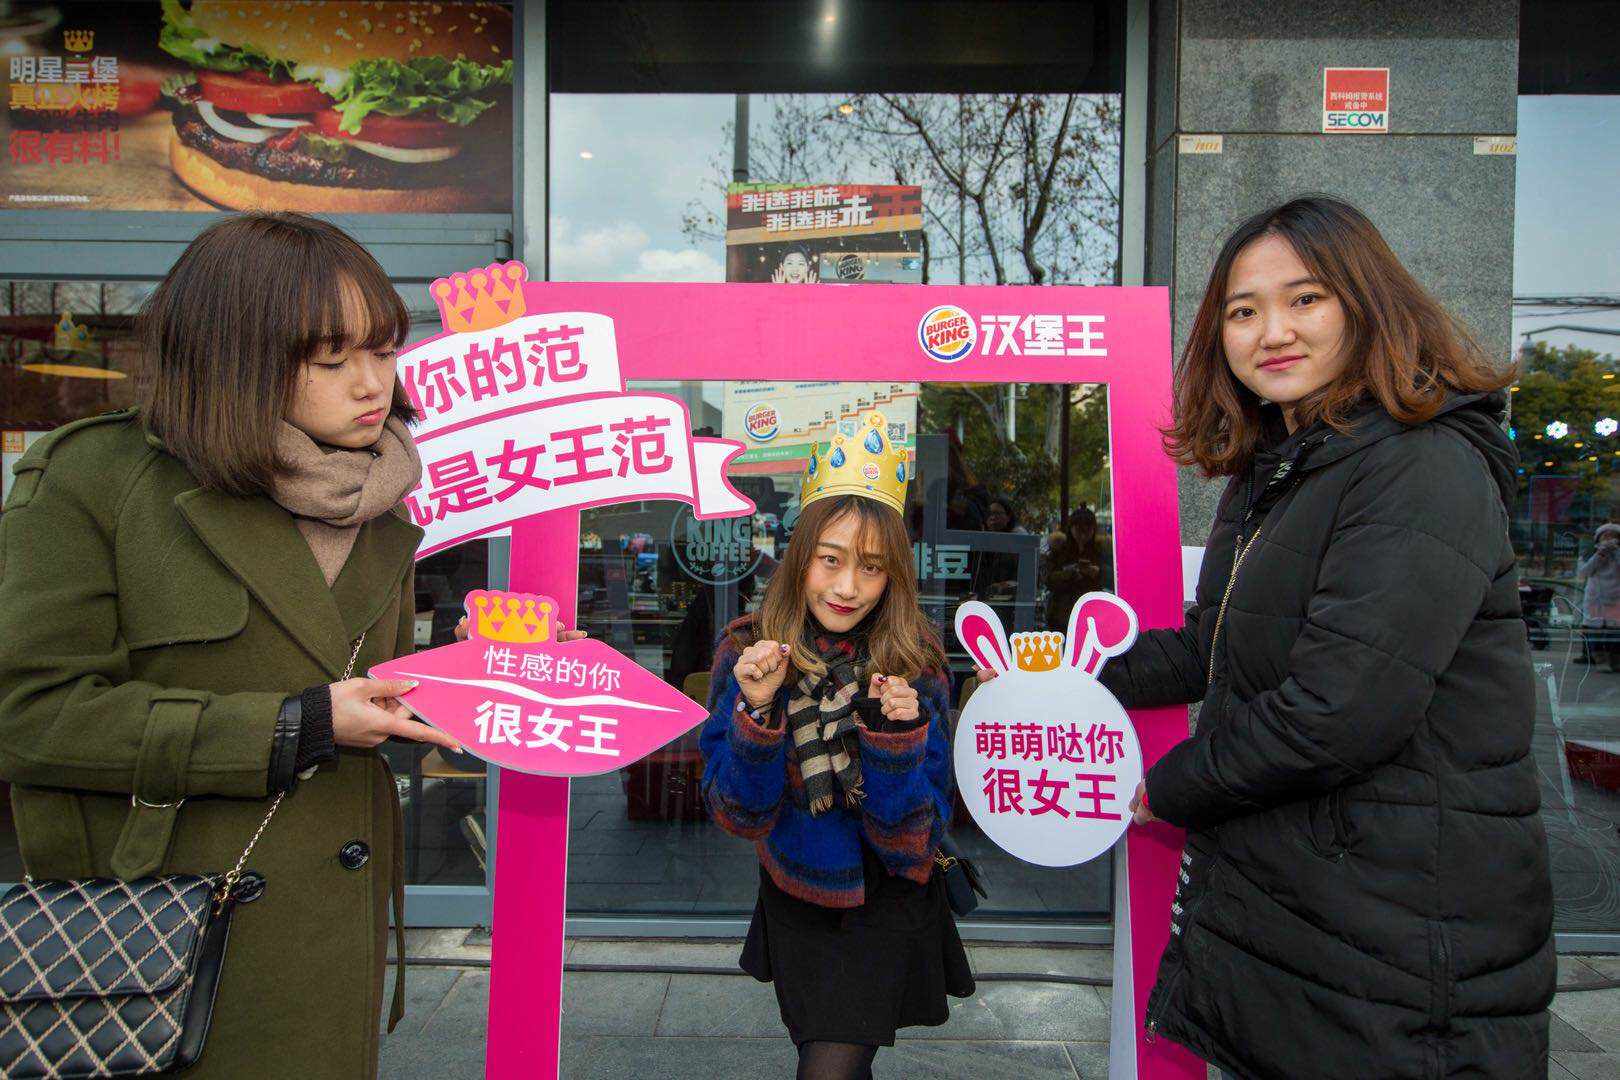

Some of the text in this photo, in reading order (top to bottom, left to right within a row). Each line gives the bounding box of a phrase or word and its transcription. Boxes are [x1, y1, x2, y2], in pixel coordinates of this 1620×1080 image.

[1327, 113, 1384, 127] SECOM
[839, 265, 864, 277] KING
[925, 316, 967, 336] BURGER
[927, 326, 970, 350] KING
[981, 314, 1108, 356] 汉堡王
[403, 324, 588, 422] 你的范
[748, 410, 776, 423] BURGER
[749, 416, 777, 432] KING
[686, 516, 751, 542] KING
[686, 542, 751, 561] COFFEE
[483, 645, 621, 692] 性感的你
[474, 700, 620, 757] 很女王
[974, 722, 1125, 764] 萌萌哒你
[983, 767, 1122, 821] 很女王
